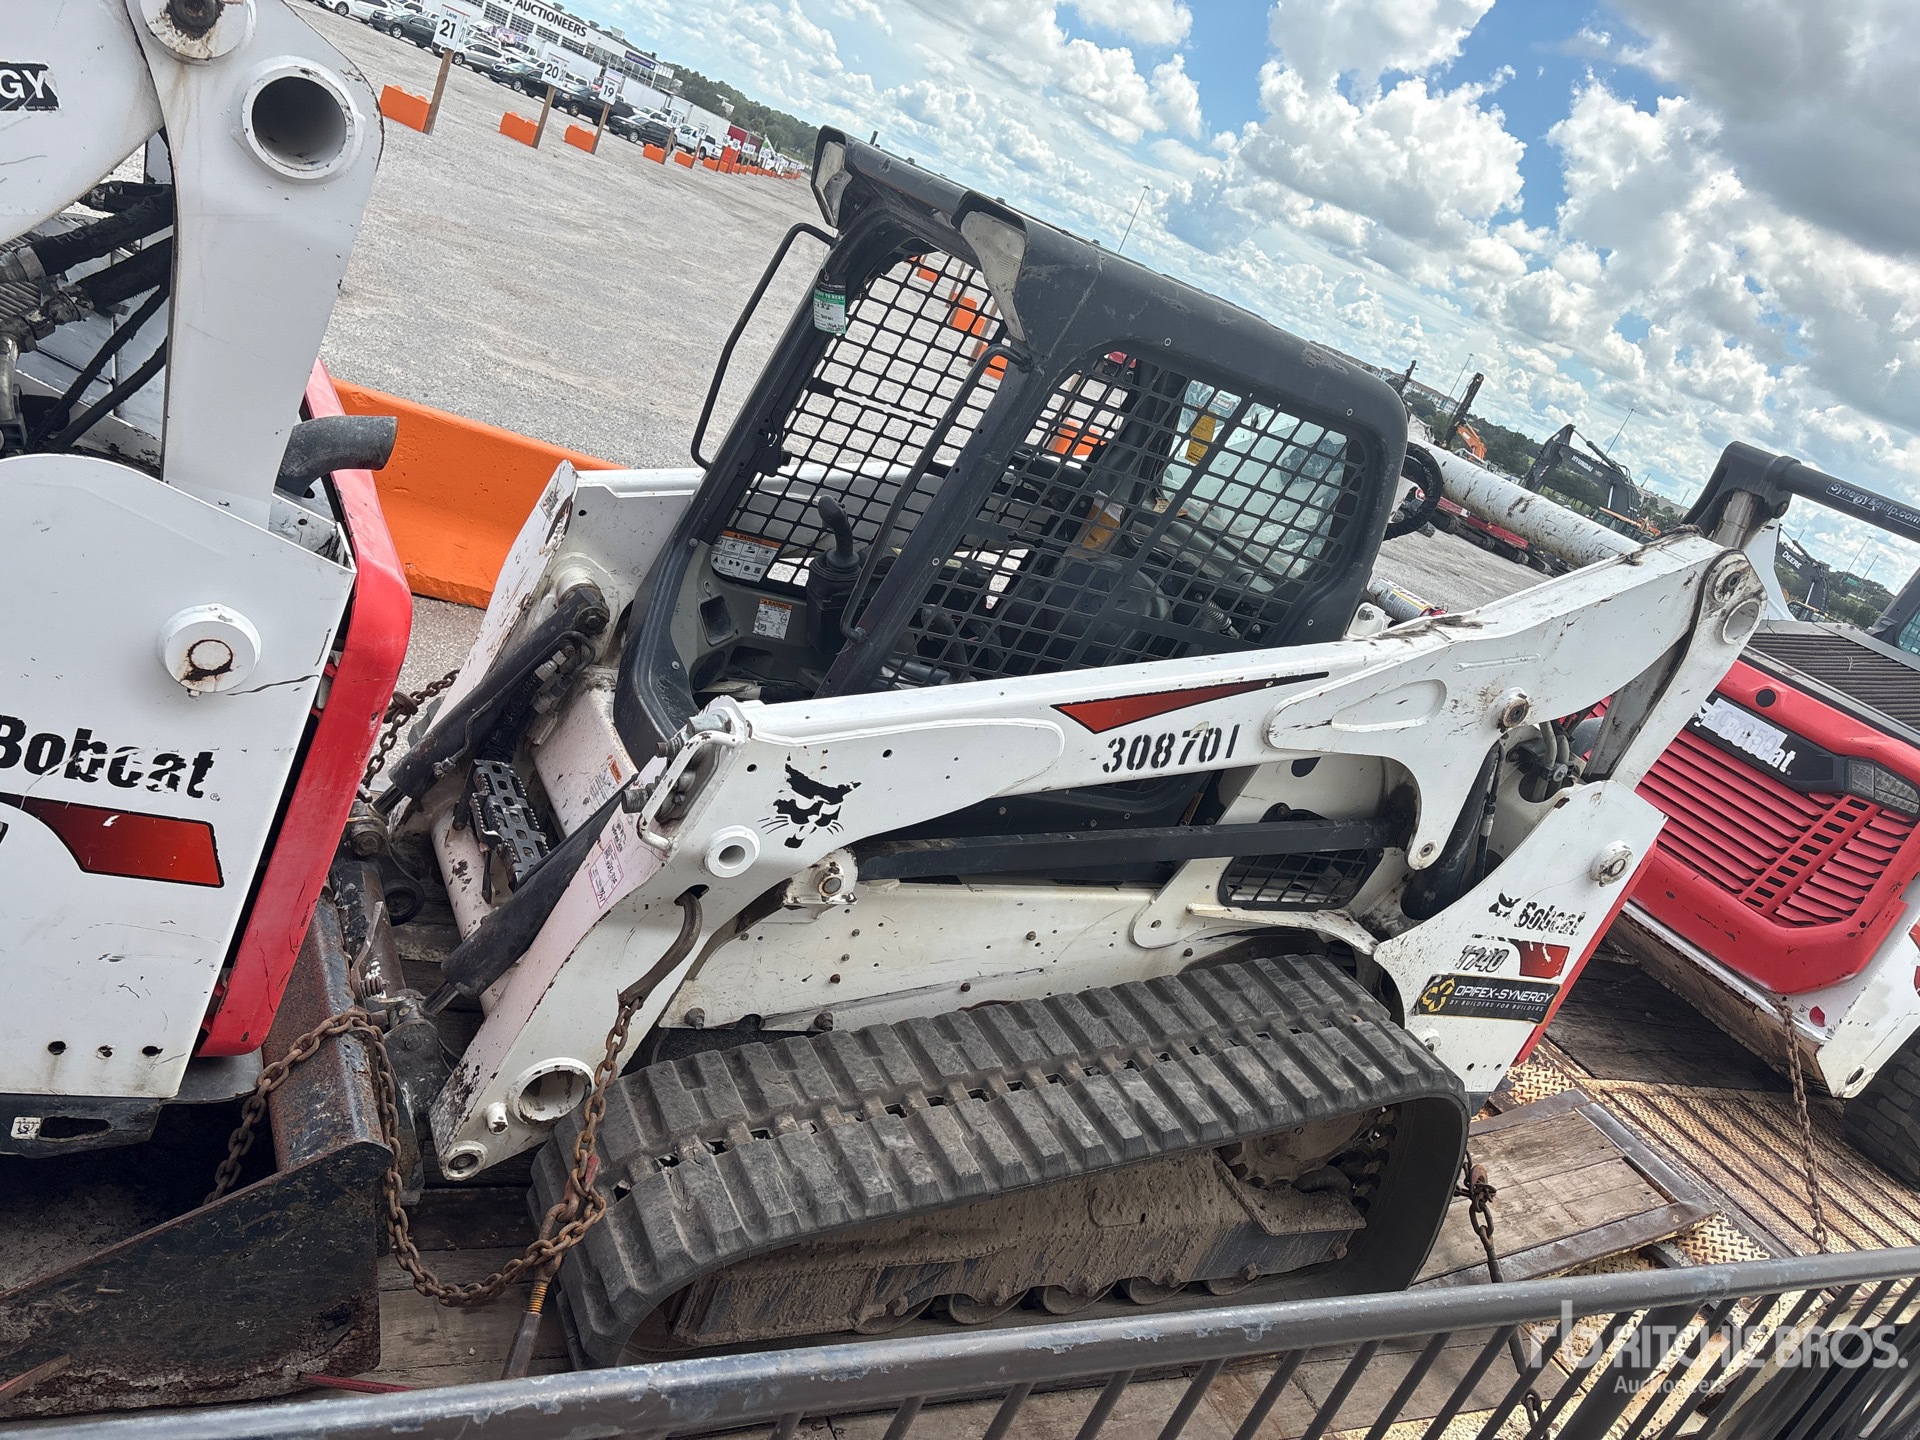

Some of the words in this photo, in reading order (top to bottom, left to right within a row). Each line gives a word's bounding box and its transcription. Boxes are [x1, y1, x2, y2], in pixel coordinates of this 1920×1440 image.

[446, 10, 457, 19] Lane
[515, 0, 588, 37] AUCTIONEERS
[439, 19, 456, 39] 21
[544, 63, 559, 79] 20
[603, 85, 615, 98] 19
[671, 115, 678, 124] 18
[1571, 455, 1594, 473] HYUNDAI
[1781, 551, 1802, 570] DEERE
[0, 715, 214, 798] Bobcat
[1102, 724, 1240, 773] 308701
[1513, 901, 1586, 936] Bobcat
[1455, 944, 1510, 972] T740
[1454, 985, 1555, 1003] OPIFEX-SYNERGY
[1512, 1004, 1545, 1012] BUILDERS
